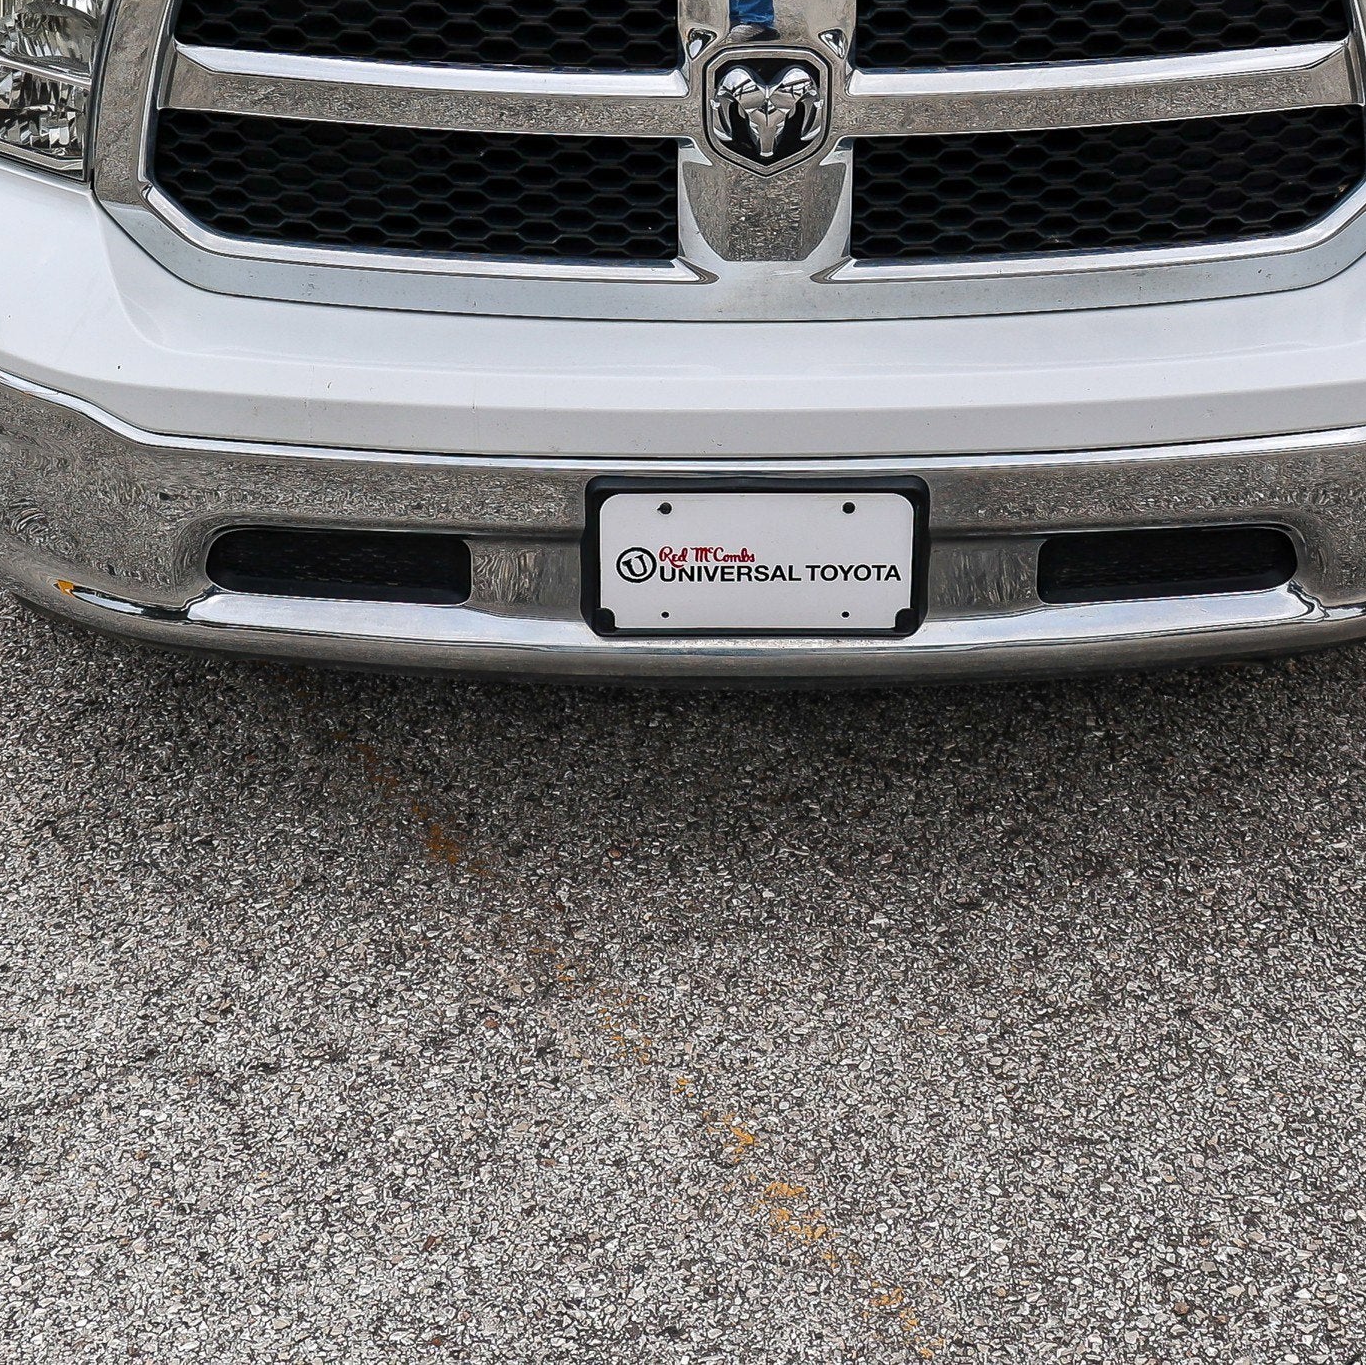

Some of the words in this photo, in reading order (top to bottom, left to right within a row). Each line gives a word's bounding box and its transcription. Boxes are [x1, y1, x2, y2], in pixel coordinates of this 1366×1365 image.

[658, 546, 688, 569] Red
[690, 546, 755, 563] McCombs
[659, 565, 802, 582] UNIVERSAL
[805, 564, 901, 581] TOYOTA
